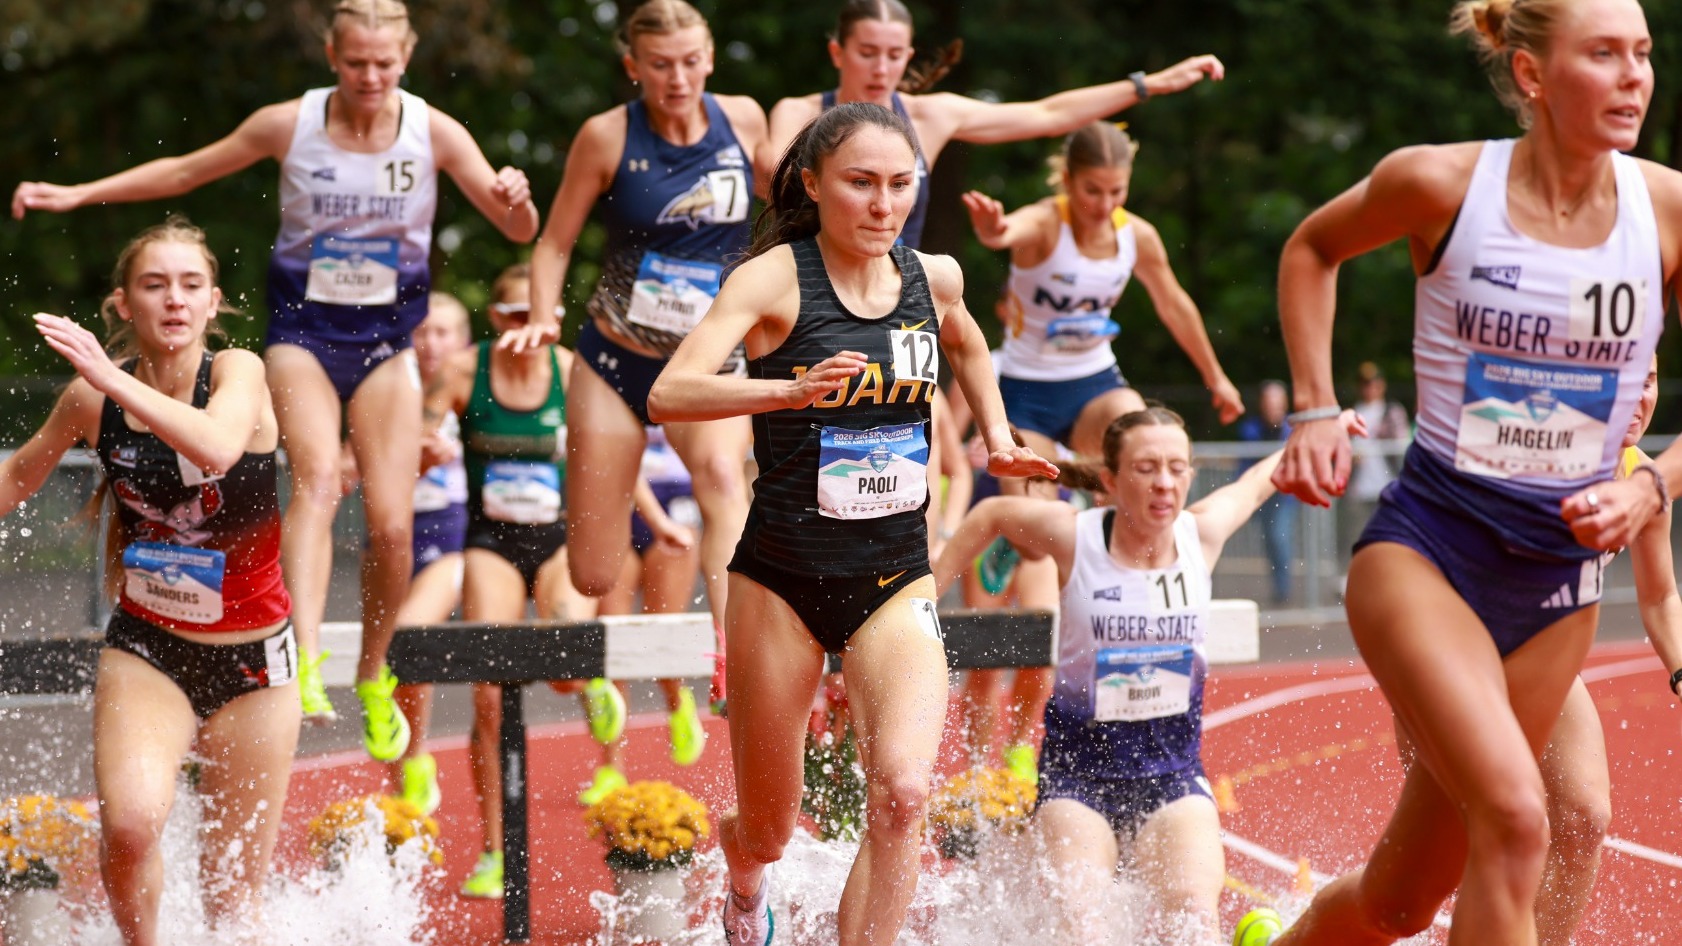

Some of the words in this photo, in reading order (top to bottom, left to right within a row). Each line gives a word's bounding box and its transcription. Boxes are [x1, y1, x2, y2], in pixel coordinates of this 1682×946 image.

[384, 160, 414, 192] 15
[311, 193, 361, 219] WEBER
[719, 176, 736, 217] 7
[1584, 282, 1636, 338] 10
[1455, 300, 1552, 355] WEBER
[901, 333, 935, 380] 12
[833, 433, 853, 441] 2026
[868, 431, 883, 439] SKY
[883, 427, 913, 438] OUTDOOR
[1497, 424, 1574, 449] HAGELIN
[858, 475, 898, 495] PAOLI
[146, 581, 200, 606] SANDERS
[1155, 572, 1188, 609] 11
[922, 601, 941, 639] 1
[1091, 614, 1148, 642] WEBER
[1156, 614, 1198, 642] STATE
[277, 636, 292, 679] 1
[1128, 686, 1162, 701] BROW
